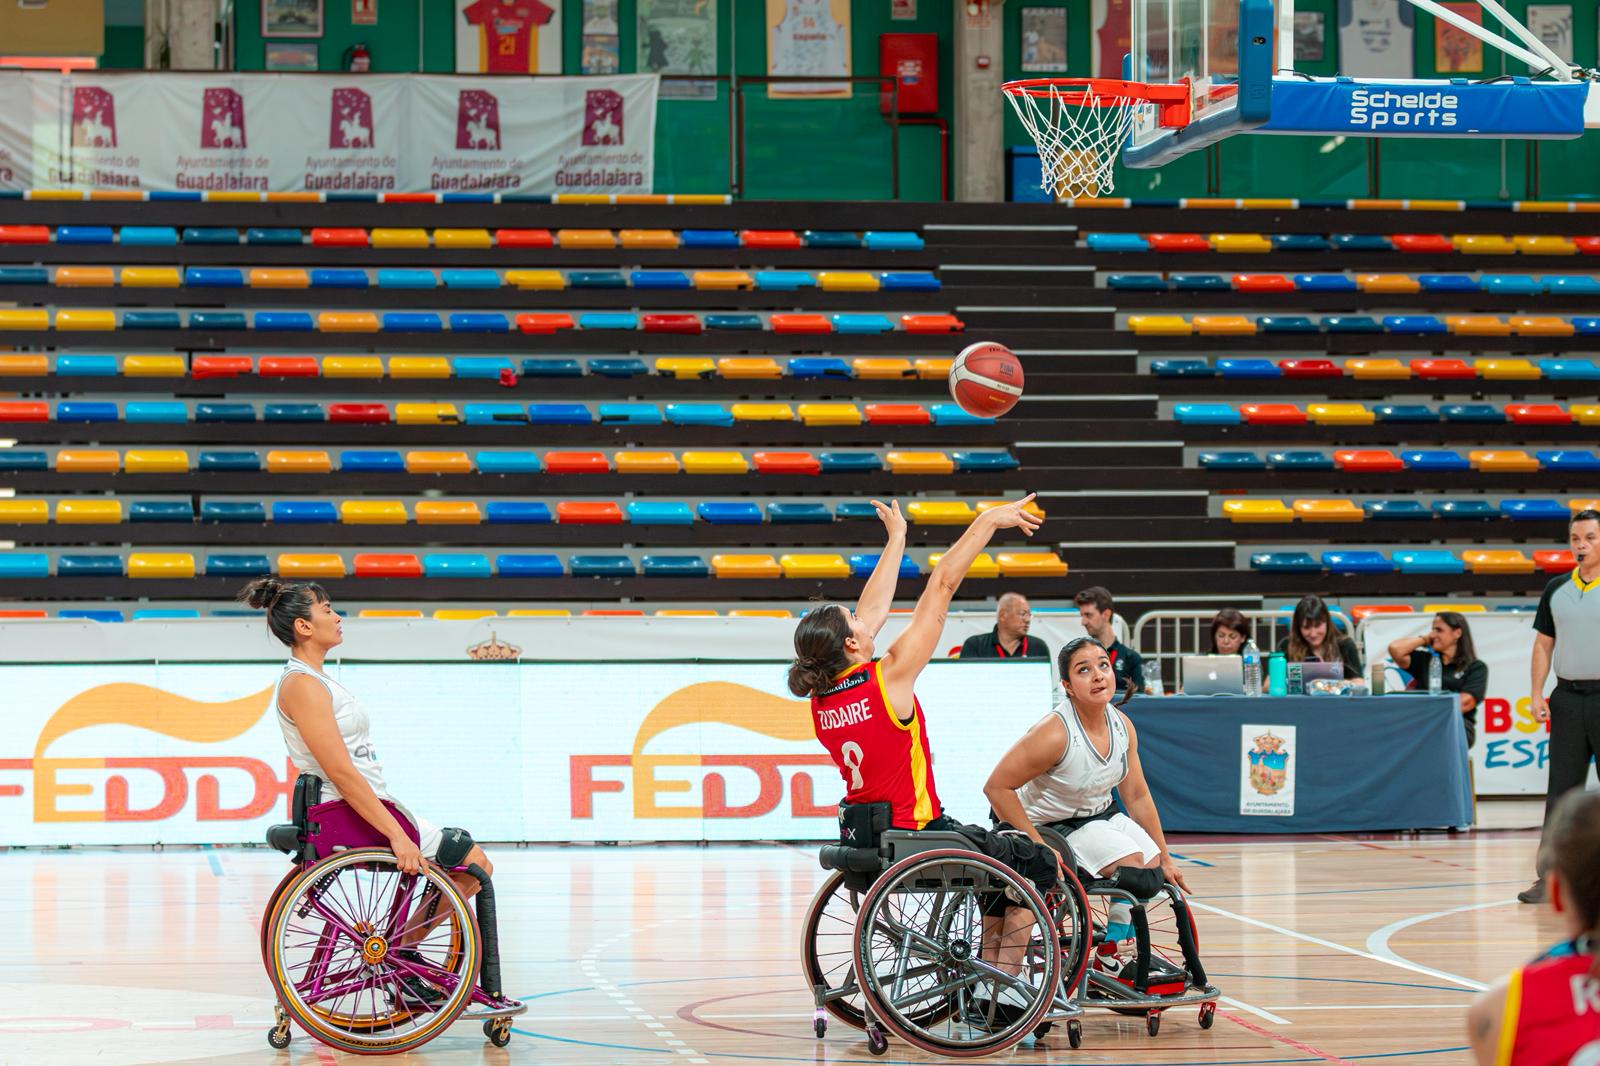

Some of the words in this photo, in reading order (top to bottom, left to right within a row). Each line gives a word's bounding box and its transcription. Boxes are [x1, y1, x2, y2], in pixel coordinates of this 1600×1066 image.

[1351, 89, 1458, 109] Schelde
[1350, 107, 1457, 129] Sports
[176, 155, 253, 169] Ayuntamiento
[255, 155, 269, 168] de
[305, 155, 380, 169] Ayuntamiento
[382, 155, 396, 168] de
[431, 156, 507, 169] Ayuntamiento
[508, 156, 523, 169] de
[558, 153, 628, 168] Ayuntamiento
[630, 152, 643, 164] de
[175, 172, 269, 190] Guadalajara
[304, 172, 395, 190] Guadalajara
[431, 172, 521, 190] Guadalajara
[555, 169, 643, 187] Guadalajara
[817, 698, 873, 730] ZUDAIRE
[1485, 697, 1550, 734] BS
